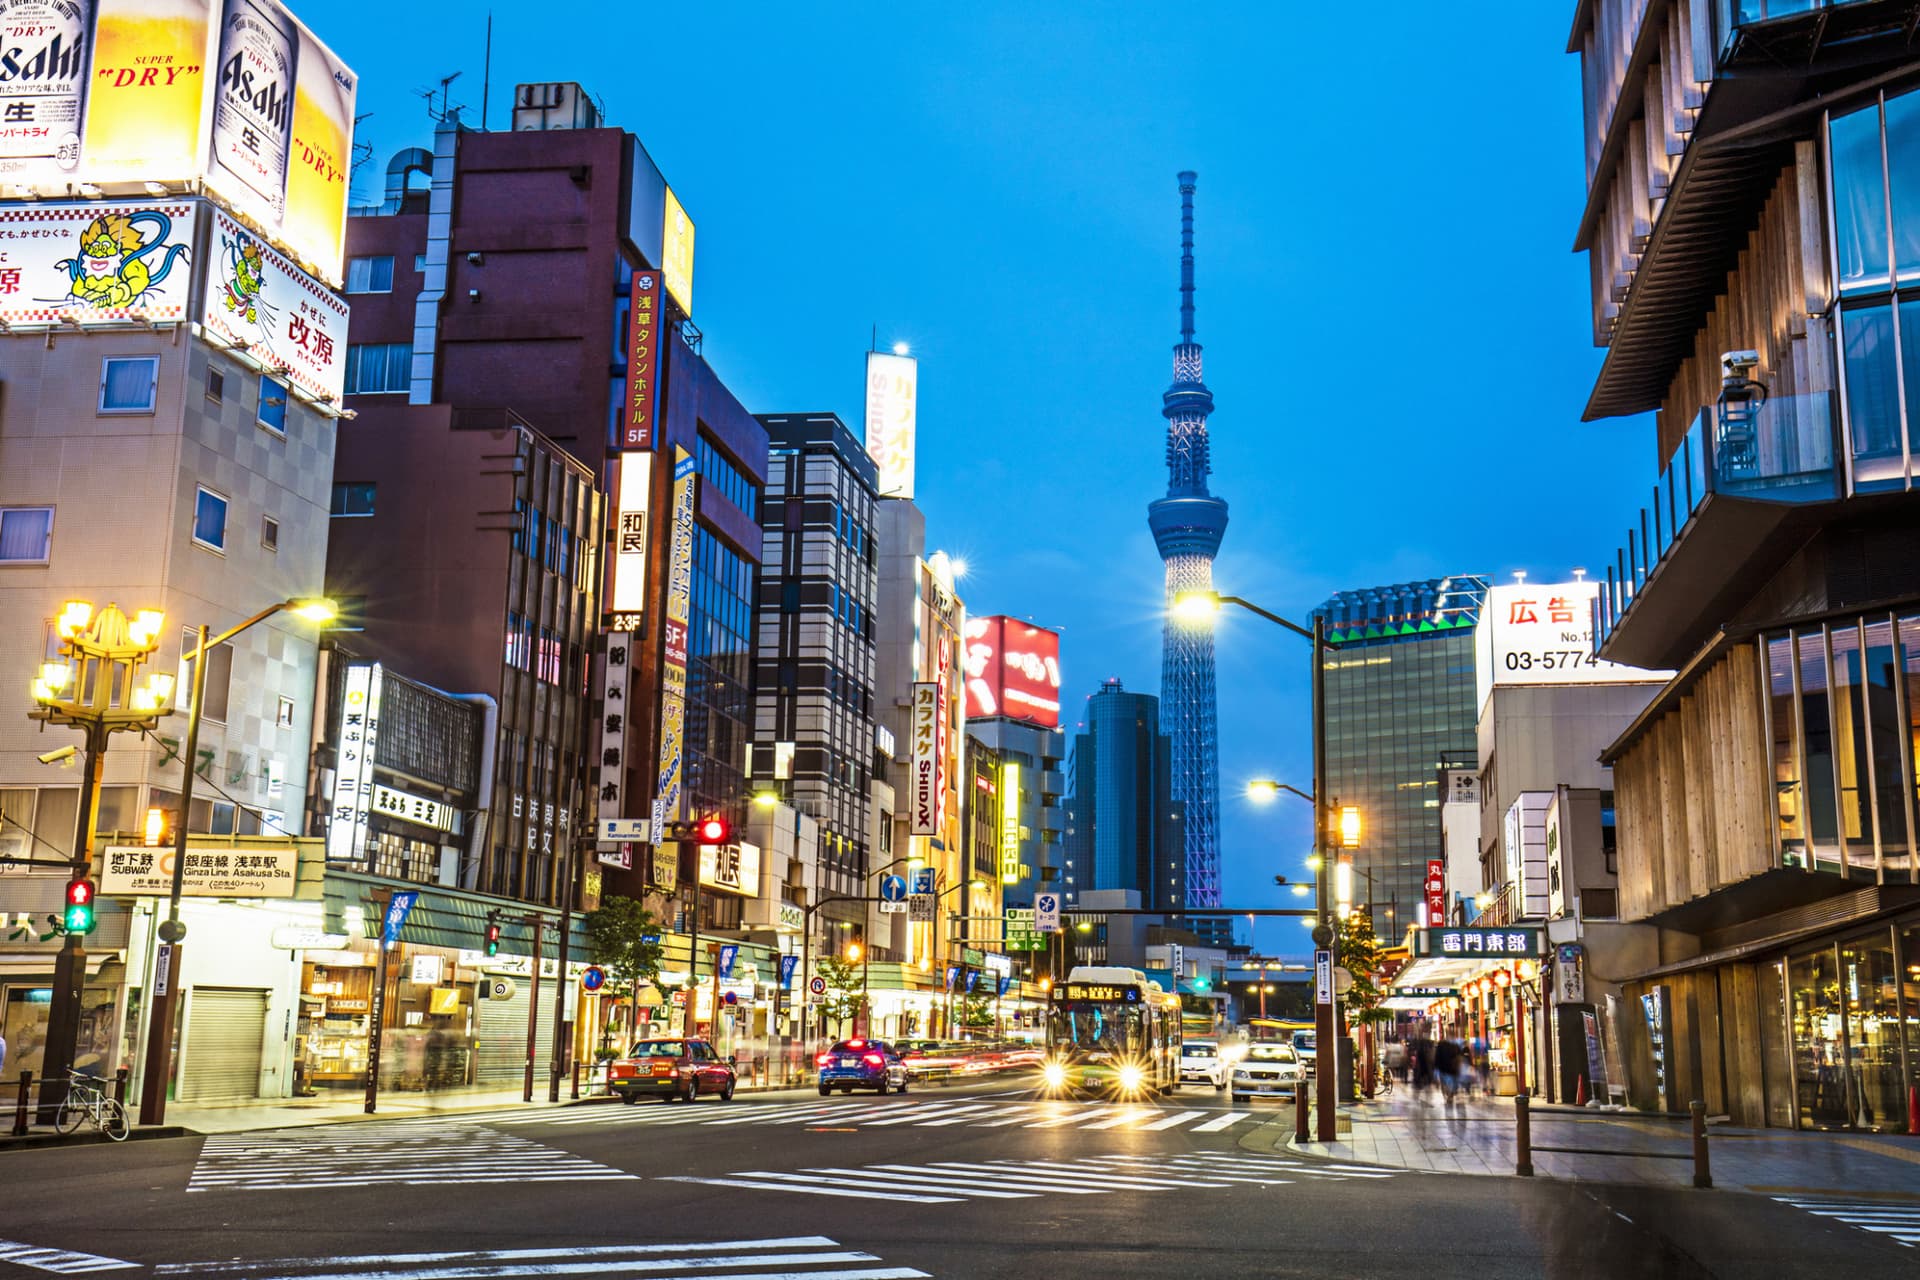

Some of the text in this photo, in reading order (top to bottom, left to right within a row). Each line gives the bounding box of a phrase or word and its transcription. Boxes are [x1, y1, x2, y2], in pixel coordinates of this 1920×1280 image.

[0, 31, 83, 81] sahi
[134, 56, 173, 64] SUPER
[222, 50, 288, 133] Asahi
[335, 71, 352, 92] Asahi
[4, 101, 36, 122] 生
[242, 127, 260, 155] 生
[301, 299, 326, 327] かぜに
[289, 311, 334, 365] 改源
[632, 296, 653, 424] 浅草タウンホテル
[628, 430, 648, 442] 5F
[622, 514, 642, 551] 和民
[1509, 598, 1593, 624] 広告
[1506, 651, 1599, 670] 03-5774
[917, 689, 933, 756] カラオケ
[334, 713, 362, 822] 天ぷら三定
[919, 760, 931, 827] SHIDAX
[110, 852, 278, 868] 地下鉄 銀座線 浅草駅
[111, 866, 151, 875] SUBWAY
[184, 867, 209, 877] Ginza
[210, 868, 229, 877] Line
[233, 868, 272, 878] Asakusa
[655, 866, 666, 883] B1
[1442, 934, 1528, 952] 雷門東部
